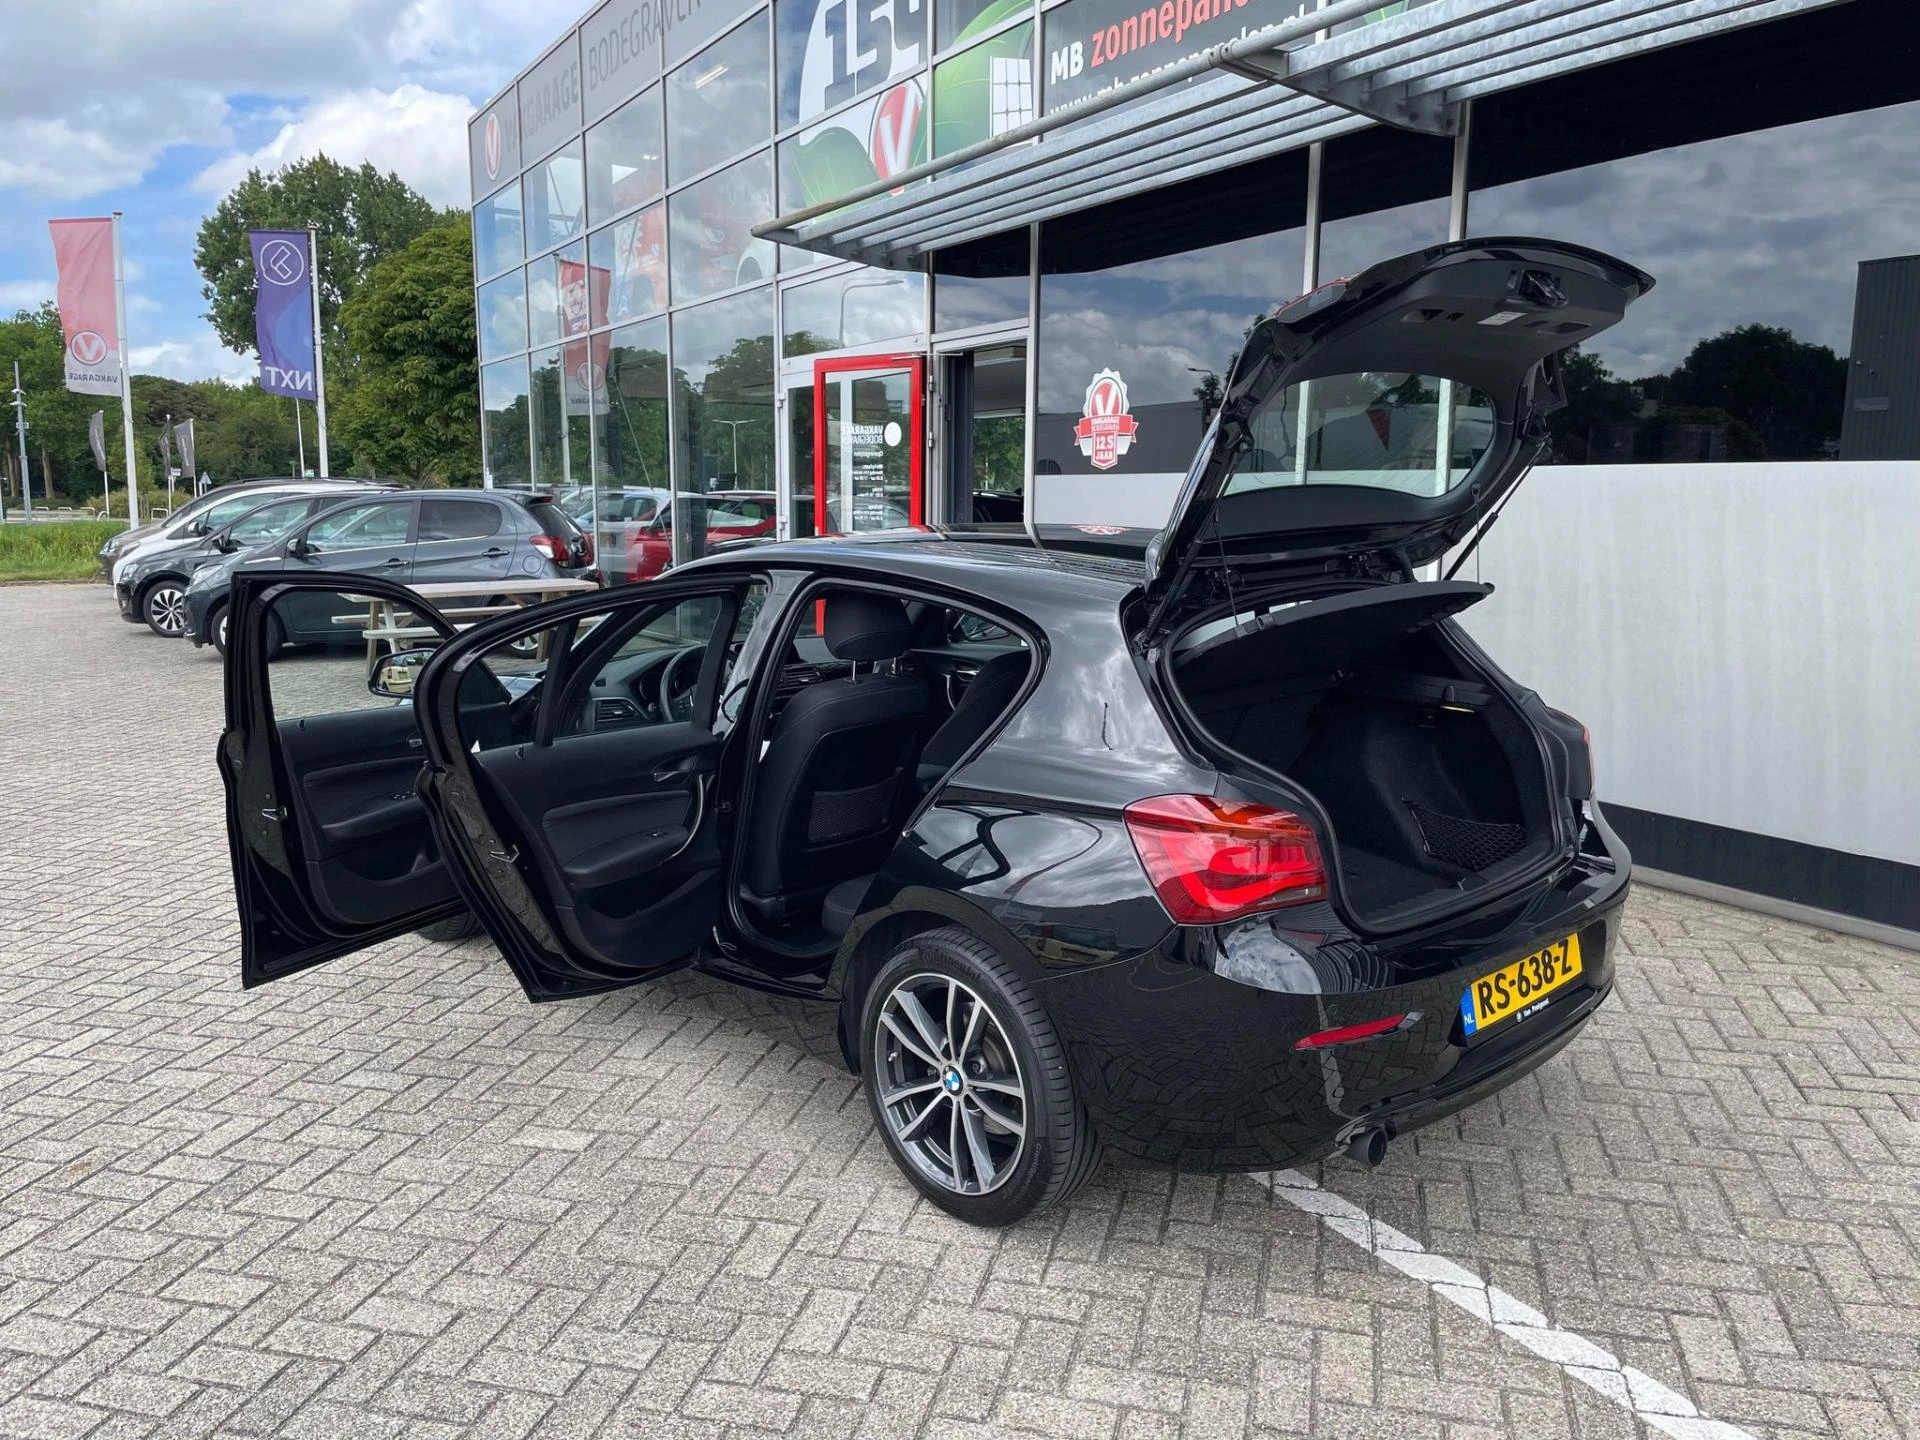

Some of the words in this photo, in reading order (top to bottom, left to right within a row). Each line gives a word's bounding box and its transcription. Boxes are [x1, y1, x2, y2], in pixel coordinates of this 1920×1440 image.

[1050, 41, 1084, 85] MB
[1096, 435, 1114, 450] 125
[1477, 938, 1573, 1020] RS-638-Z
[1464, 1015, 1474, 1024] NL
